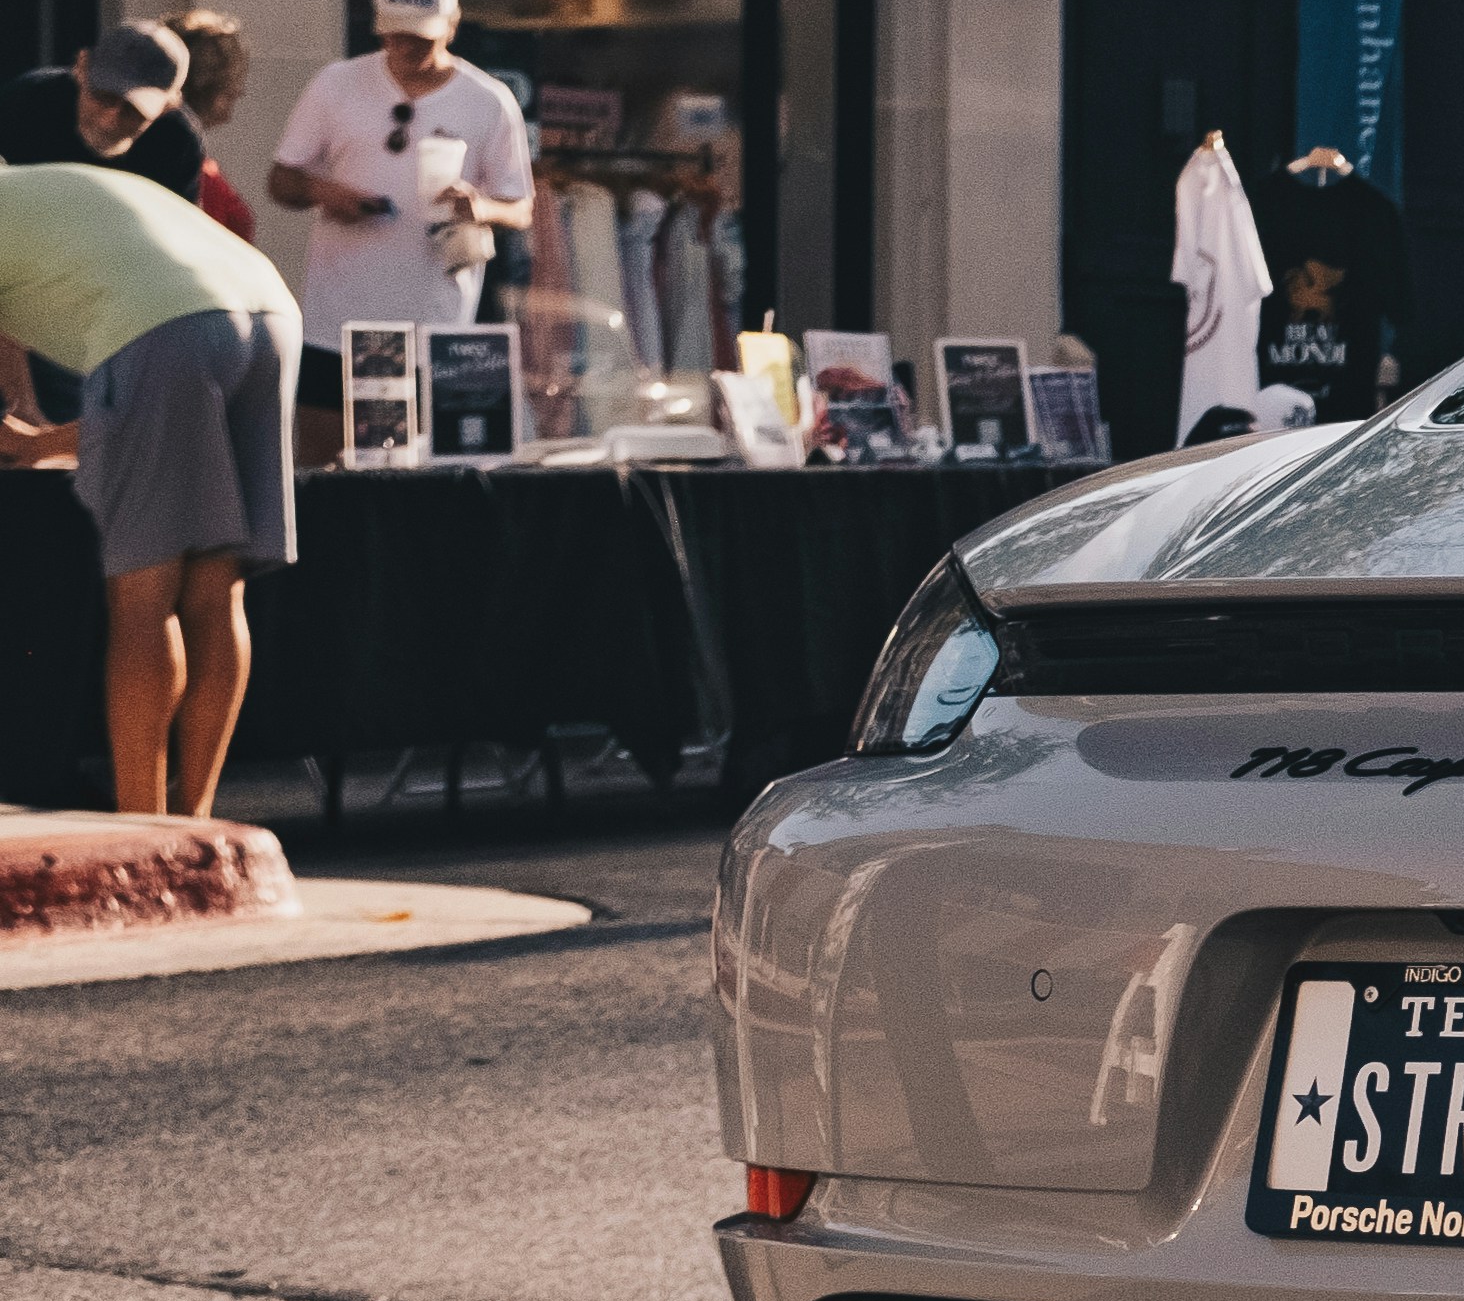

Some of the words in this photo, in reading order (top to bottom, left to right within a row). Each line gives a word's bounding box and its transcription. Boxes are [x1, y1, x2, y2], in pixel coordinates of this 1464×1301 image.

[1229, 746, 1348, 780] 718
[1404, 965, 1462, 983] INDIGO
[1290, 1194, 1413, 1235] Porsche
